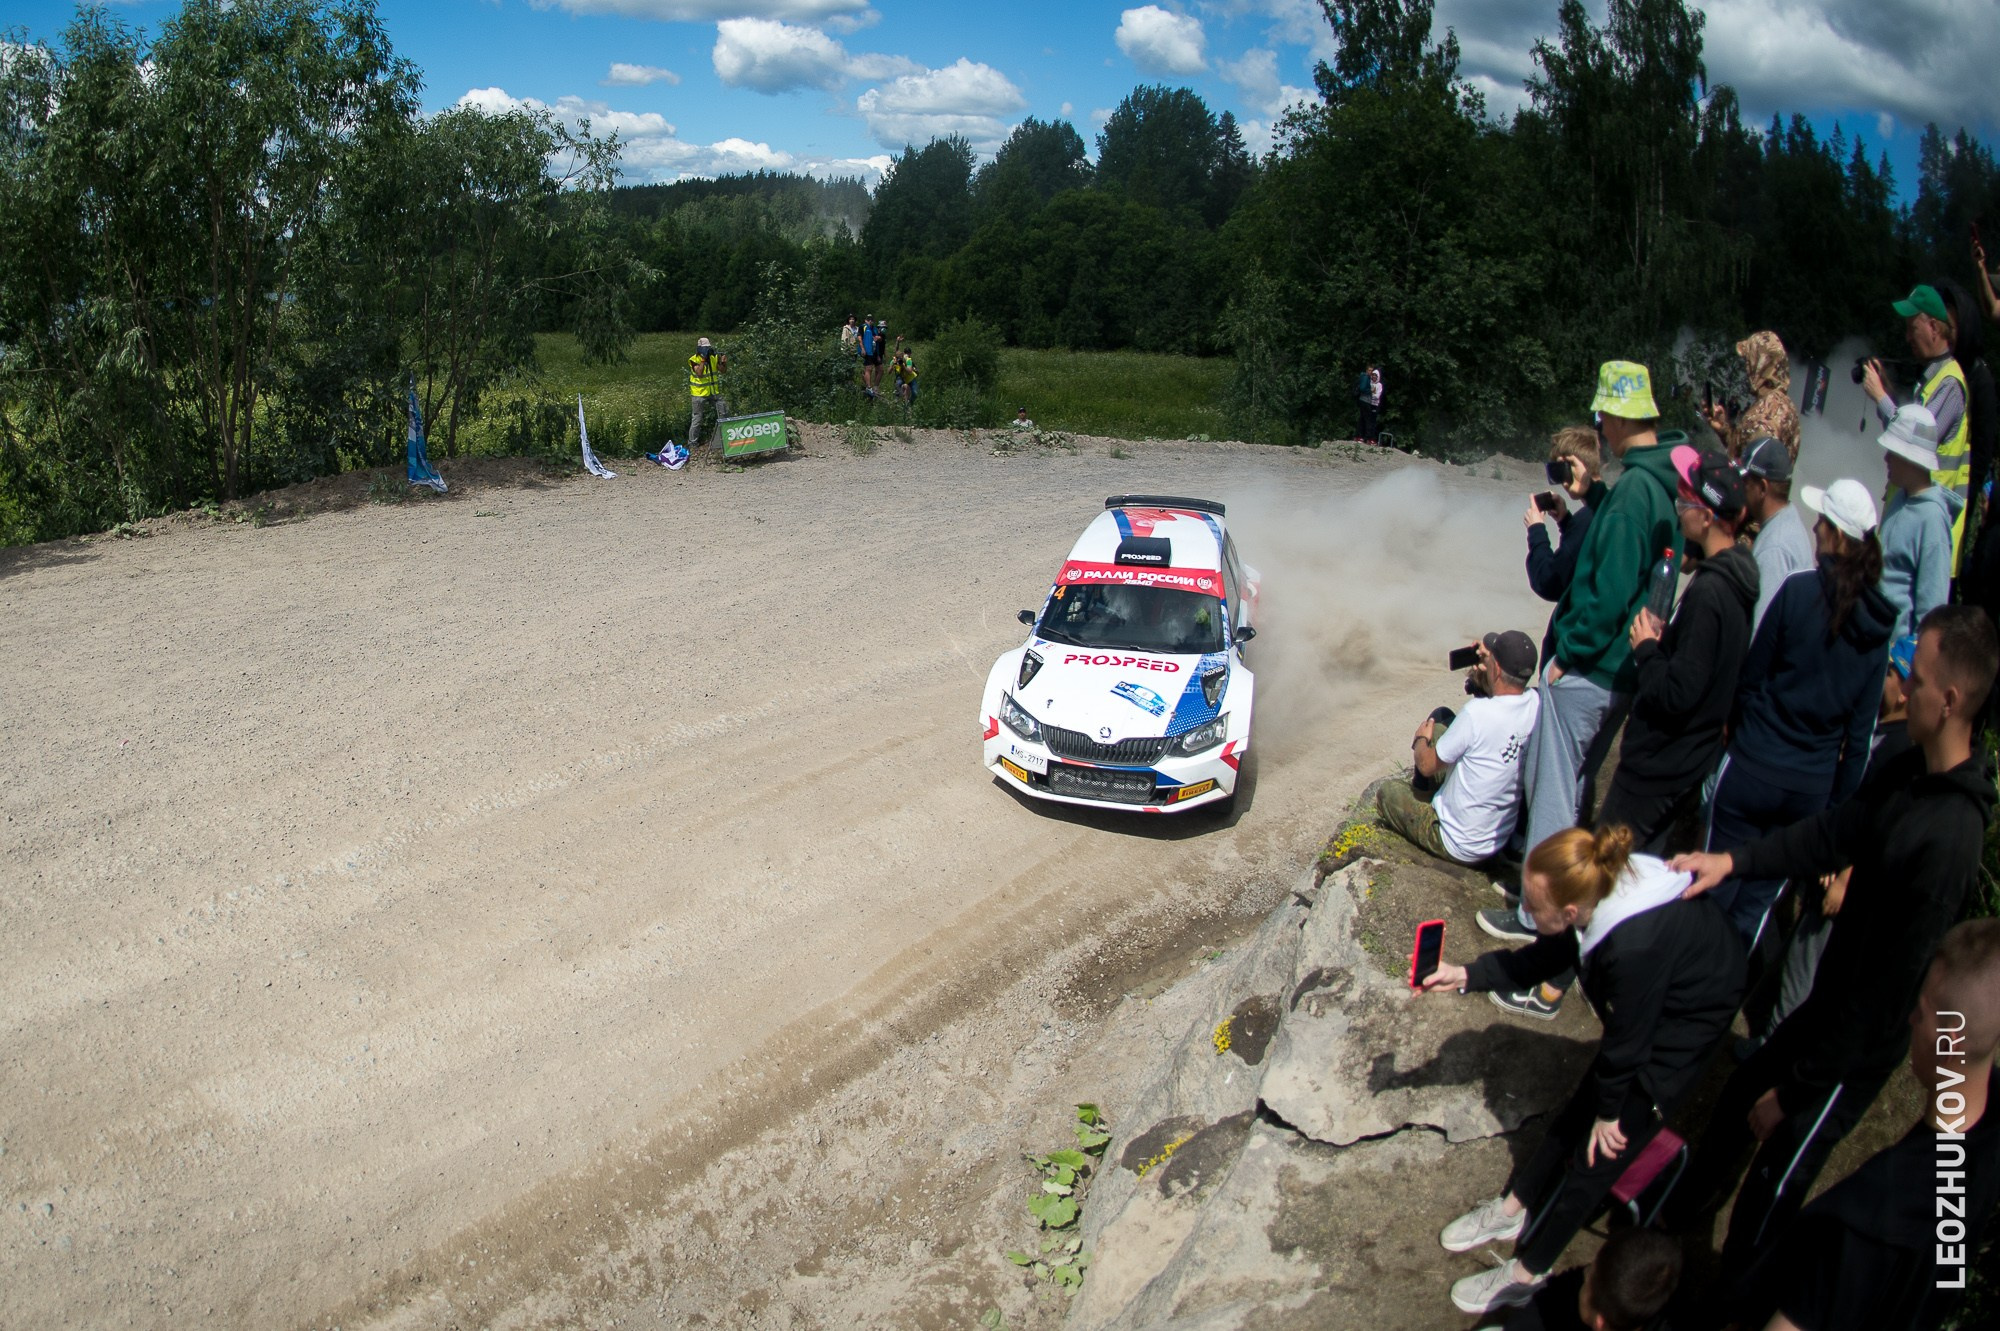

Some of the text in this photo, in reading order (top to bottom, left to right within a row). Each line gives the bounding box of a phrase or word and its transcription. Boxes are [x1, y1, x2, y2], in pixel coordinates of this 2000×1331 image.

[1121, 553, 1162, 561] PROSPEED
[1083, 571, 1133, 580] РАЛЛИ
[1137, 573, 1195, 586] РОССИИ
[1053, 586, 1067, 600] 4
[1063, 654, 1180, 673] PROSPEED
